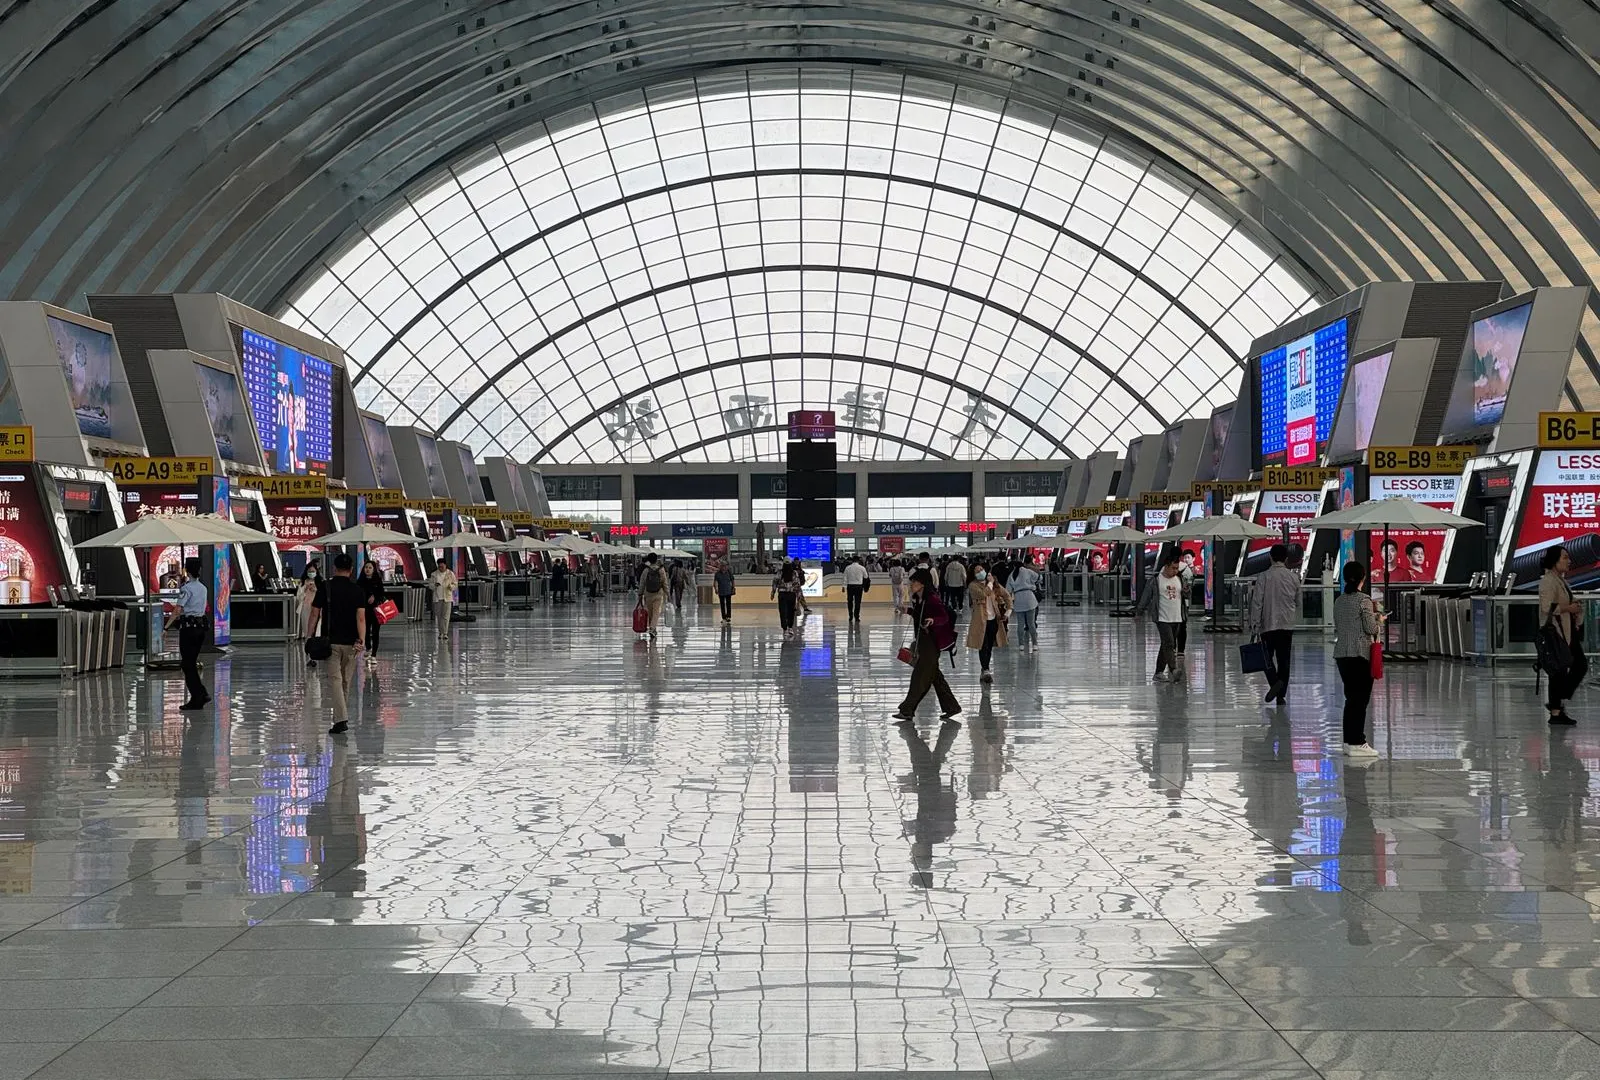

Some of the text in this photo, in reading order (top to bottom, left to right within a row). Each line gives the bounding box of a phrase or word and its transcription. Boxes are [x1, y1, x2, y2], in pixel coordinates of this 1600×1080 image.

[1375, 451, 1430, 468] B8-B9
[113, 462, 208, 480] A8-A9 检票口
[1269, 471, 1313, 485] B10-B11
[293, 481, 322, 489] 检票口
[1383, 479, 1454, 490] LESSO 联塑
[1275, 494, 1312, 503] LESSO
[1543, 493, 1600, 518] 联塑
